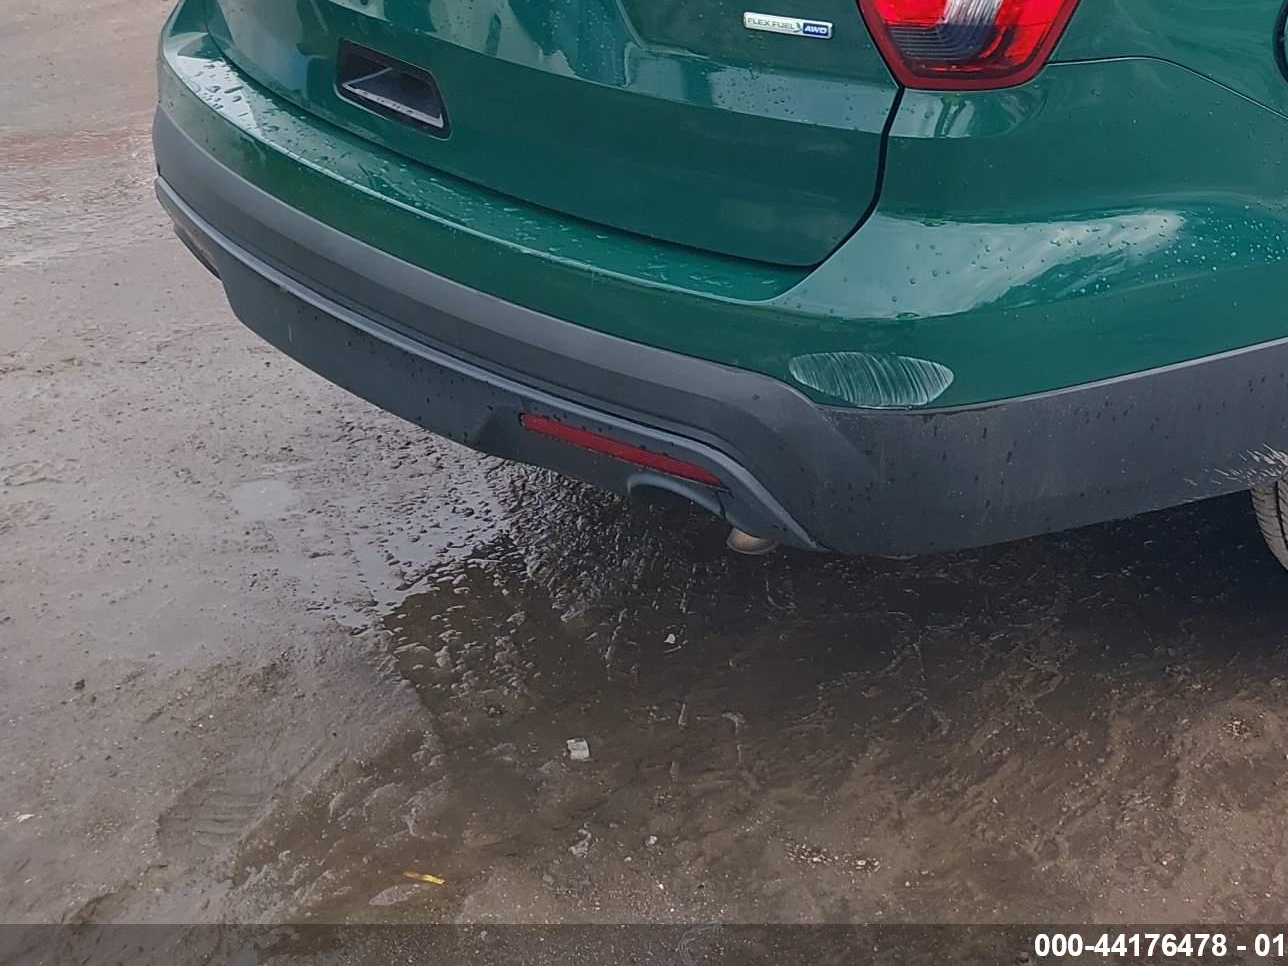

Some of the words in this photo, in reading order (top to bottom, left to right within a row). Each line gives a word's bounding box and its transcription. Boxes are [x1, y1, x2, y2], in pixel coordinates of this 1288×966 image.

[747, 17, 771, 26] FLEX
[772, 20, 795, 29] FUEL
[804, 25, 828, 34] AWD
